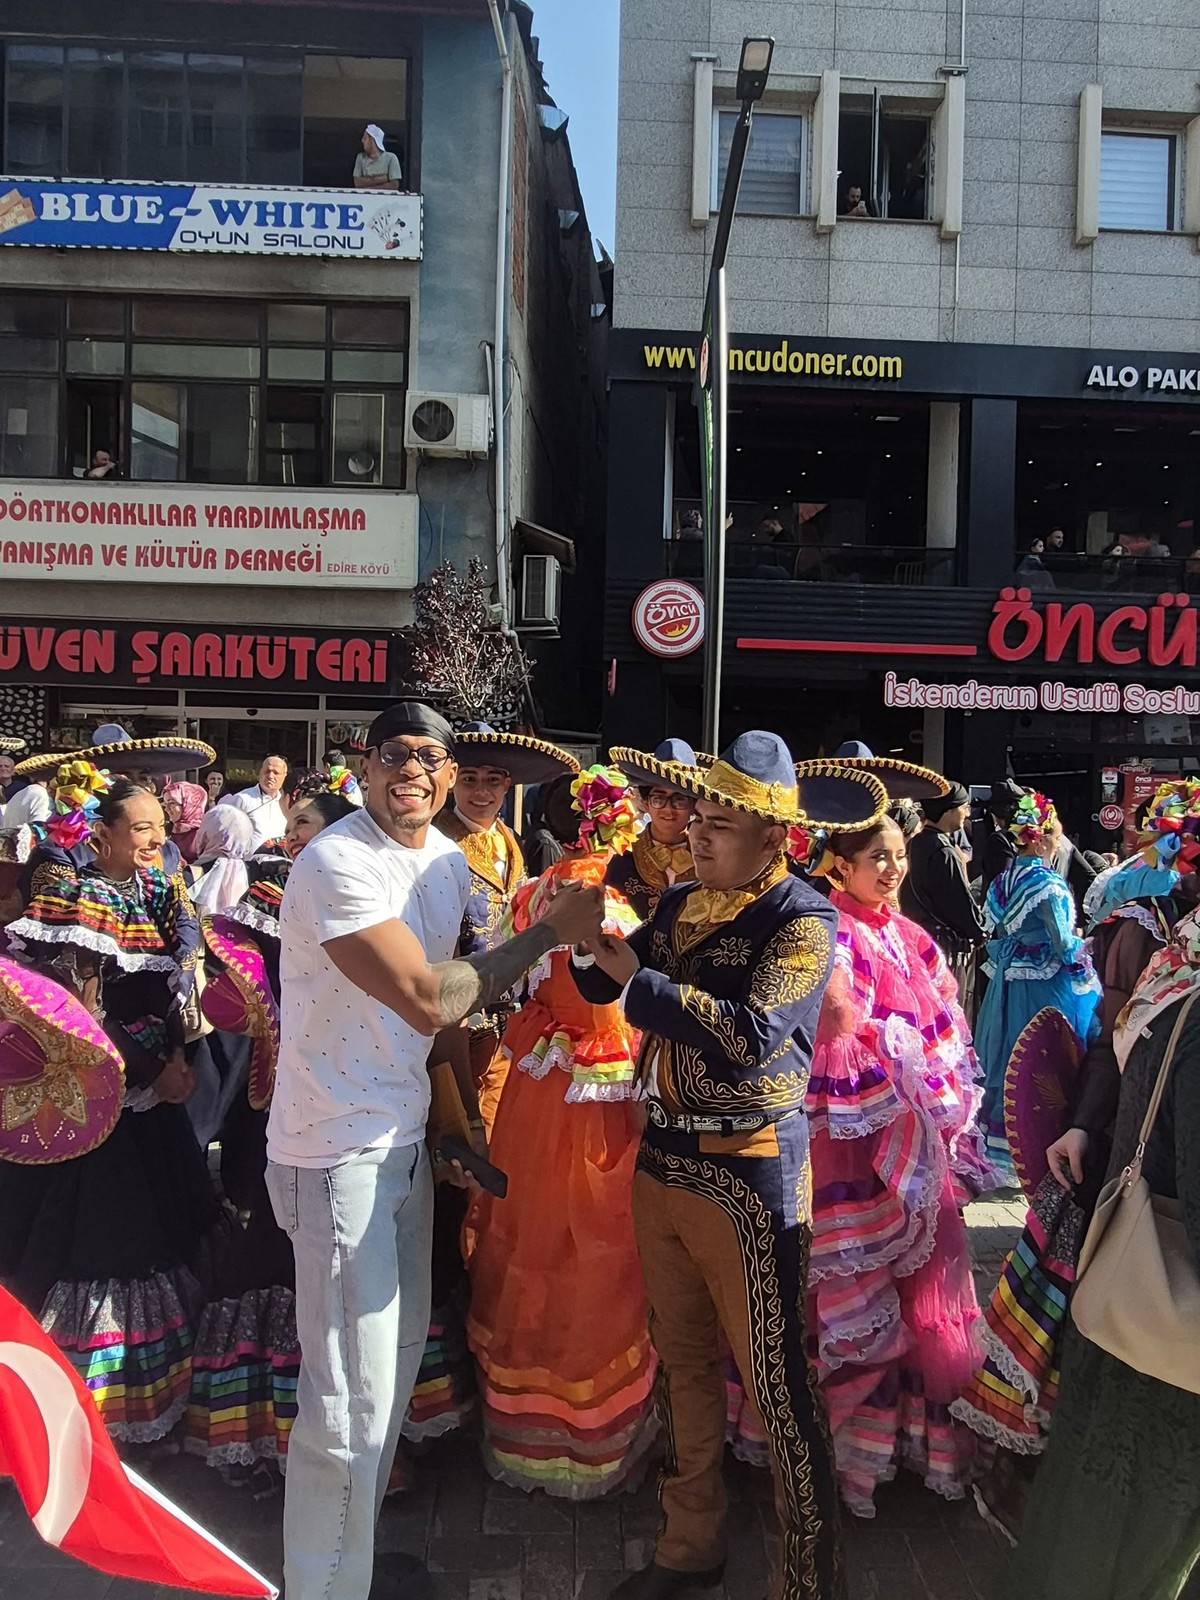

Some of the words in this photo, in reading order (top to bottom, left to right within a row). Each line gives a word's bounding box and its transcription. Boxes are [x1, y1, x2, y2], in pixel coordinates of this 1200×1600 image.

[40, 192, 164, 225] BLUE
[208, 199, 365, 231] WHITE
[180, 231, 249, 246] OYUN
[263, 233, 364, 251] SALONU
[1087, 365, 1139, 388] ALO
[1147, 367, 1200, 391] PAK
[205, 505, 366, 536] YARDIMLAŞMA
[0, 540, 93, 571] ANIŞMA
[101, 544, 127, 567] VE
[135, 539, 217, 570] KÜLTÜR
[224, 543, 322, 573] DERNEĞİ
[360, 562, 390, 575] KÖYÜ
[0, 626, 115, 673] ÜVEN
[131, 630, 388, 684] ŞARKÜTERİ
[885, 671, 1037, 710] İskenderun
[1041, 682, 1120, 712] Usulü
[1124, 684, 1200, 714] Soslu
